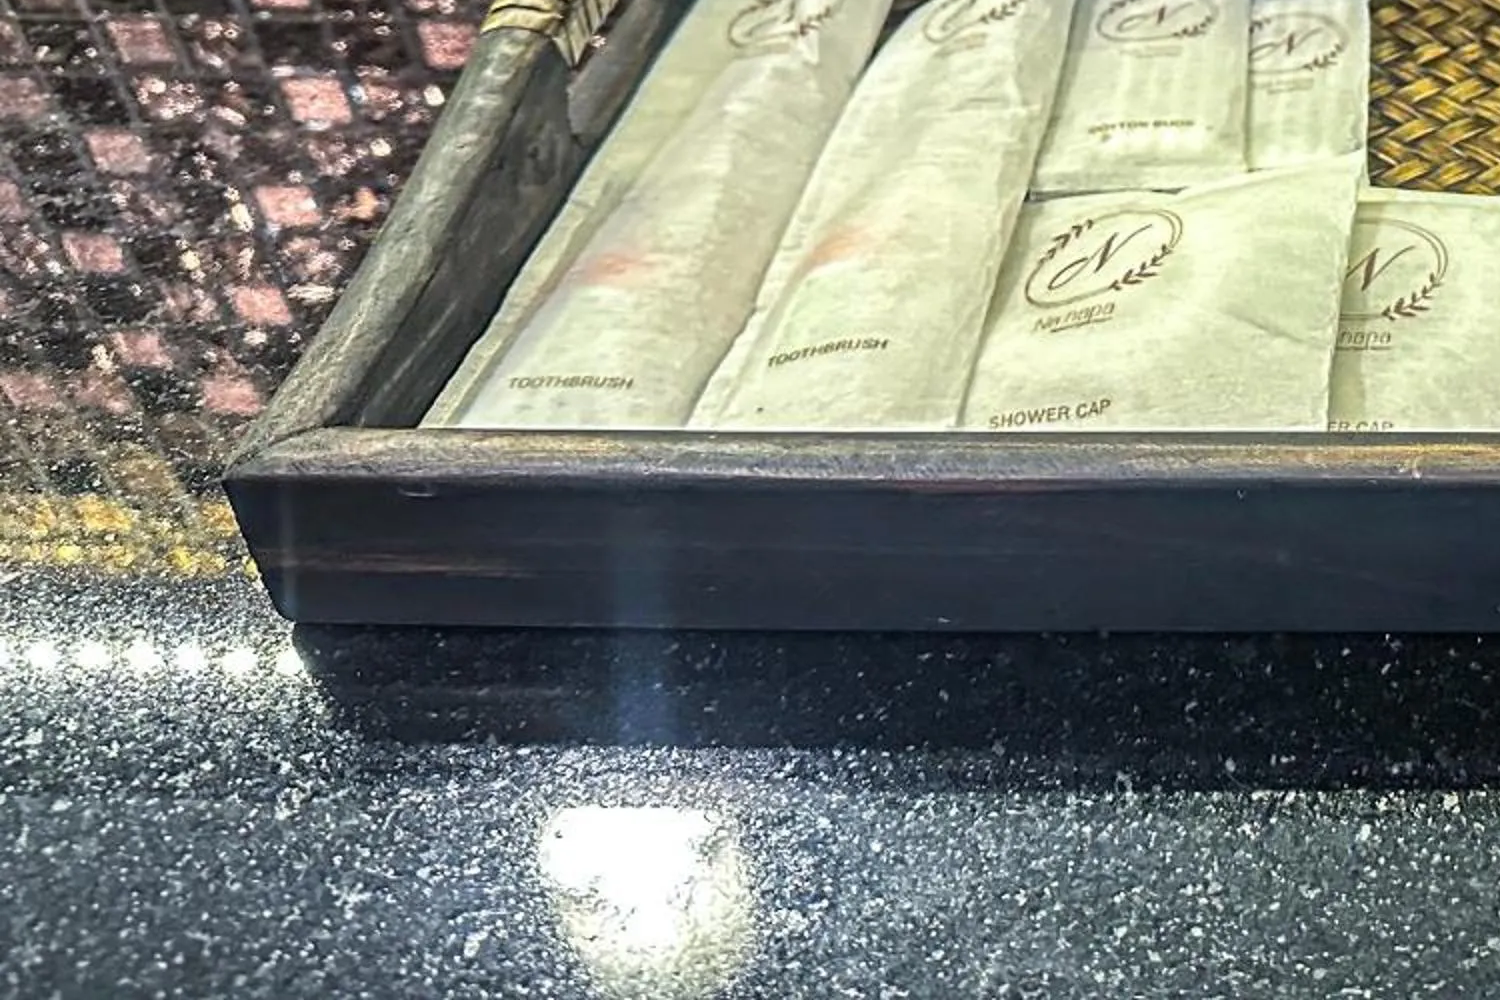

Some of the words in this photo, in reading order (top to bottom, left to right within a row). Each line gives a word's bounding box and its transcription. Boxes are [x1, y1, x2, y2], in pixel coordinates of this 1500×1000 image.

[1046, 223, 1153, 291] N
[768, 338, 889, 368] TOOTHBRUSH
[509, 375, 635, 390] TOOTHBRUSH
[989, 405, 1070, 430] SHOWER
[1075, 398, 1111, 420] CAP
